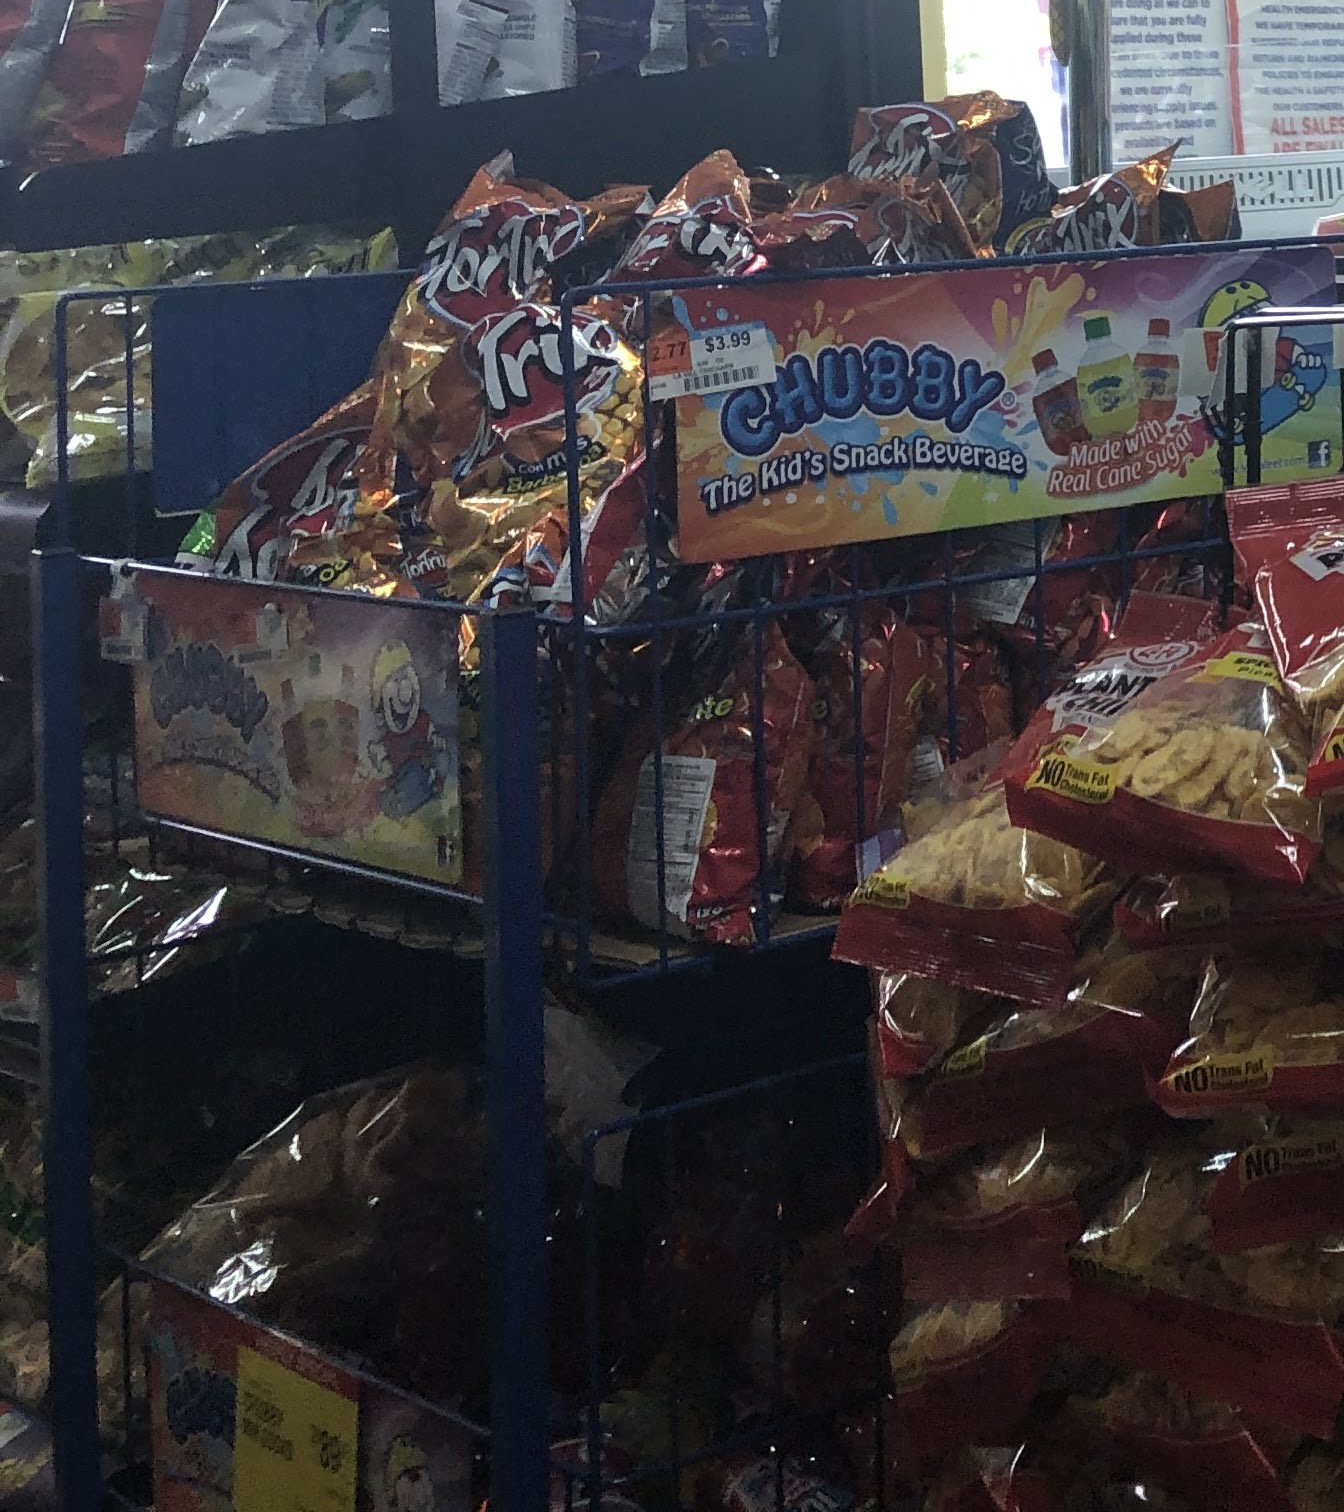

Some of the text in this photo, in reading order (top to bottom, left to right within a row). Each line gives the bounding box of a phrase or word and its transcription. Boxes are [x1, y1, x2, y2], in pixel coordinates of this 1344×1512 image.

[1270, 117, 1298, 137] ALL
[704, 330, 751, 353] $3.99
[720, 336, 1006, 458] CHUBBY
[1049, 468, 1092, 494] Real
[1095, 460, 1143, 489] Cane
[1146, 423, 1195, 474] Sugar
[1069, 419, 1166, 469] Made with
[703, 437, 1028, 511] The Kid's Snack Beverage
[1036, 757, 1066, 788] NO
[1064, 762, 1111, 787] Trans Fat
[1174, 1065, 1209, 1094] NO
